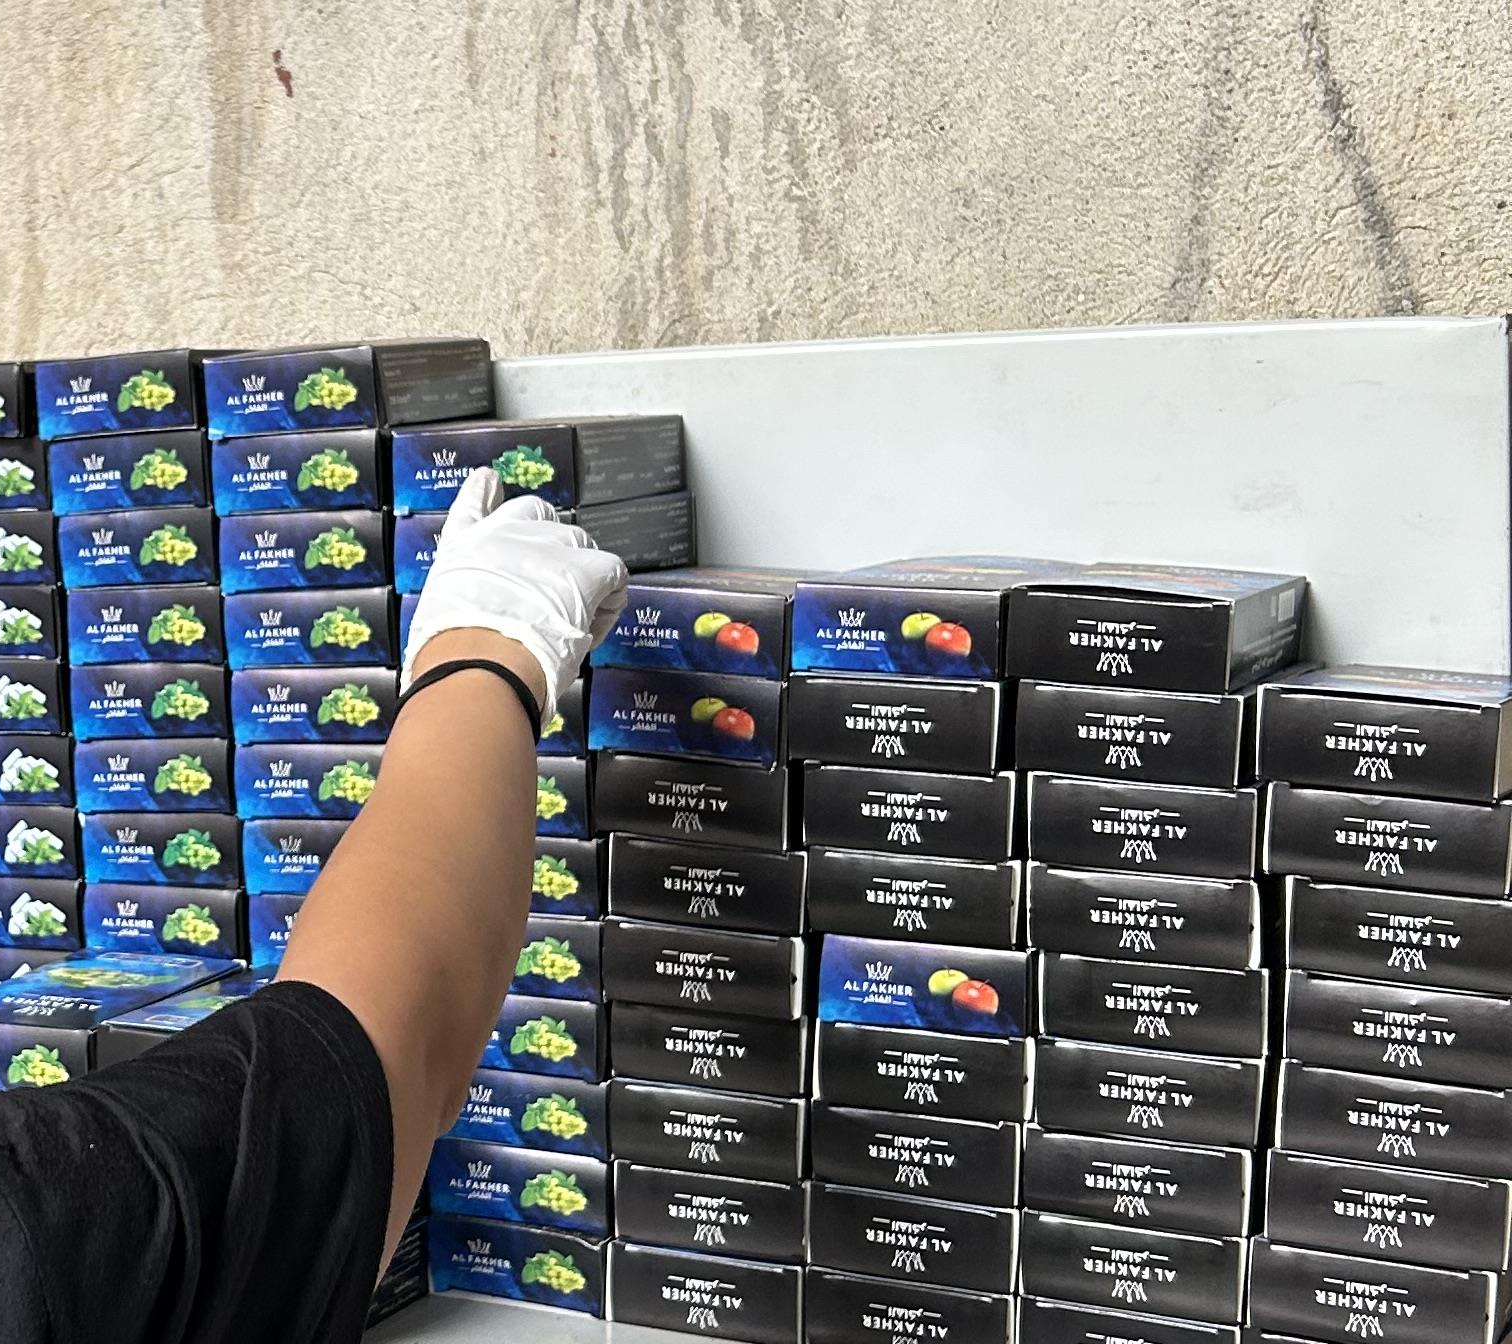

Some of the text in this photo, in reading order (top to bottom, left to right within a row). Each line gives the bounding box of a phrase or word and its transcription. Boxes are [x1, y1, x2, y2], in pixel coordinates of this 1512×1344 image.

[55, 392, 108, 406] AL FAKHER
[226, 391, 284, 404] AL FAKHER
[68, 470, 121, 483] AL FAKHER
[231, 470, 287, 482] AL FAKHER
[415, 470, 430, 480] AL
[78, 545, 130, 556] AL FAKHER
[239, 548, 294, 560] AL FAKHER
[416, 550, 430, 561] AL
[86, 623, 138, 633] AL FAKHER
[244, 627, 299, 638] AL FAKHER
[615, 626, 678, 638] AL FAKHER
[816, 627, 885, 641] AL FAKHER
[1068, 632, 1162, 651] AL FAKHER
[89, 698, 142, 708] AL FAKHER
[251, 702, 307, 713] AL FAKHER
[612, 710, 675, 722] AL FAKHER
[844, 716, 931, 733] AL FAKHER
[1077, 725, 1171, 744] AL FAKHER
[1325, 735, 1426, 755] AL FAKHER
[92, 772, 145, 782] AL FAKHER
[253, 778, 309, 788] AL FAKHER
[647, 793, 727, 810] AL FAKHER
[860, 803, 947, 821] AL FAKHER
[1091, 819, 1186, 838] AL FAKHER
[1334, 830, 1437, 851] AL FAKHER
[101, 845, 154, 854] AL FAKHER
[263, 854, 319, 863] AL FAKHER
[663, 877, 744, 895] AL FAKHER
[865, 890, 952, 908] AL FAKHER
[101, 917, 154, 928] AL FAKHER
[1089, 909, 1184, 928] AL FAKHER
[269, 931, 283, 941] AL
[1357, 925, 1460, 947] AL FAKHER
[655, 962, 735, 979] AL FAKHER
[843, 980, 912, 995] AL FAKHER
[1104, 996, 1198, 1014] AL FAKHER
[1352, 1021, 1456, 1044] AL FAKHER
[664, 1038, 745, 1057] AL FAKHER
[876, 1062, 964, 1082] AL FAKHER
[1098, 1084, 1192, 1105] AL FAKHER
[466, 1104, 510, 1118] FAKHER
[663, 1122, 743, 1141] AL FAKHER
[1346, 1111, 1449, 1135] AL FAKHER
[868, 1145, 954, 1165] AL FAKHER
[448, 1178, 511, 1193] AL FAKHER
[1084, 1174, 1177, 1195] AL FAKHER
[667, 1204, 749, 1224] AL FAKHER
[1333, 1201, 1434, 1225] AL FAKHER
[865, 1229, 951, 1251] AL FAKHER
[451, 1253, 512, 1268] AL FAKHER
[1082, 1258, 1176, 1281] AL FAKHER
[661, 1287, 742, 1307] AL FAKHER
[1314, 1290, 1416, 1315] AL FAKHER
[862, 1316, 948, 1336] AL FAKHER
